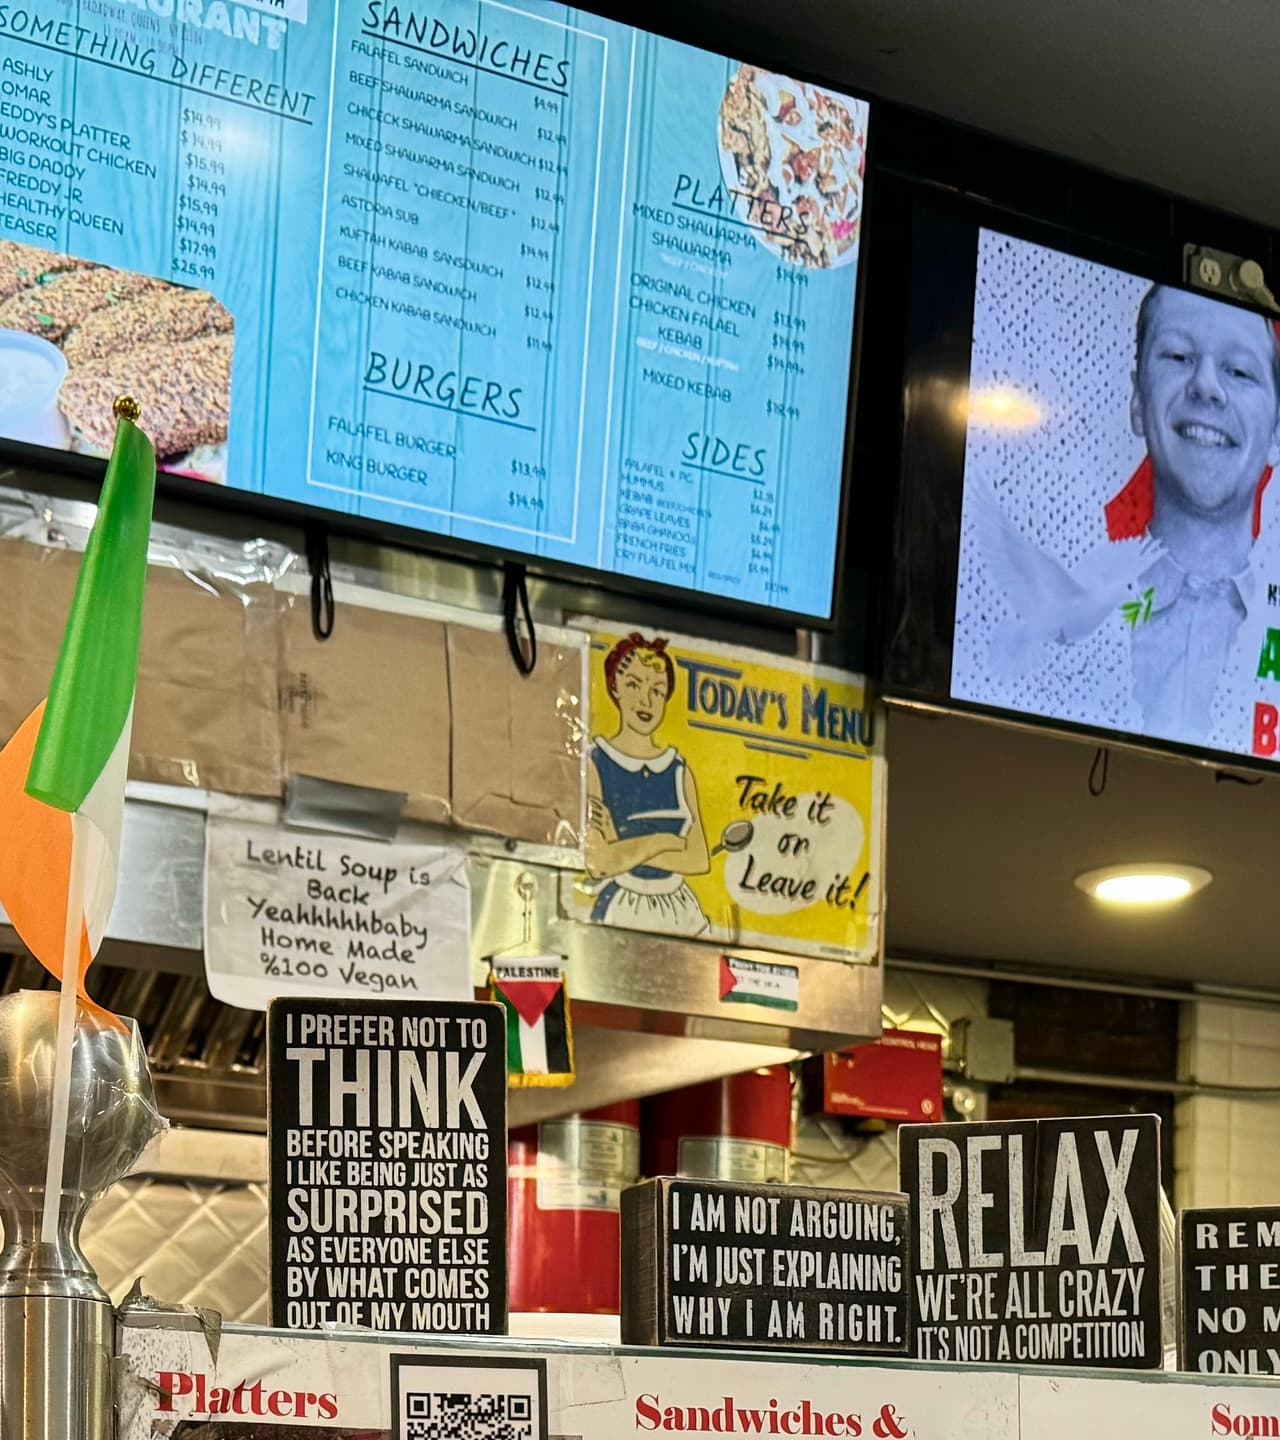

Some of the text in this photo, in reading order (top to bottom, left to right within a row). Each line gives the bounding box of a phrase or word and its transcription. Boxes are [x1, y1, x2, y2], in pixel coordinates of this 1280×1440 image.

[362, 1, 570, 87] SANDWICHES
[2, 57, 54, 83] ASHLY
[170, 55, 316, 116] DIFFERENT
[1, 81, 52, 106] OMAR
[171, 259, 215, 280] $25.99
[364, 351, 522, 419] BURGERS
[326, 449, 428, 486] KING BURGER
[682, 431, 766, 475] SIDES
[736, 775, 836, 824] Take it
[777, 832, 810, 856] or
[247, 840, 431, 893] Lentil Soup is
[738, 854, 870, 910] Leave it!
[307, 879, 370, 906] Back
[248, 897, 429, 949] Yeahhhhhbaby
[260, 927, 416, 964] Home Made
[260, 952, 419, 993] %100 Vegan
[495, 965, 560, 979] PALESTINE
[287, 1014, 487, 1048] I PREFER NOT TO
[286, 1048, 487, 1129] THINK
[287, 1130, 489, 1160] BEFORE SPEAKING
[287, 1161, 487, 1188] I LIKE BEING JUST AS
[287, 1188, 488, 1235] SURPRISED
[673, 1191, 902, 1246] I AM NOT ARGUING,
[918, 1128, 1145, 1271] RELAX
[287, 1237, 489, 1264] AS EVERYONE ELSE
[673, 1244, 902, 1293] I'M JUST EXPLAINING
[287, 1266, 489, 1299] BY WHAT COMES
[915, 1267, 1146, 1322] WE'RE ALL CRAZY
[287, 1301, 490, 1331] OUT OF MY MOUTH
[672, 1295, 902, 1344] WHY I AM RIGHT.
[1196, 1305, 1247, 1335] NO
[917, 1320, 1146, 1361] IT'S NOT A COMPETITION
[154, 1371, 339, 1420] Platters
[636, 1393, 908, 1439] Sandwiches &
